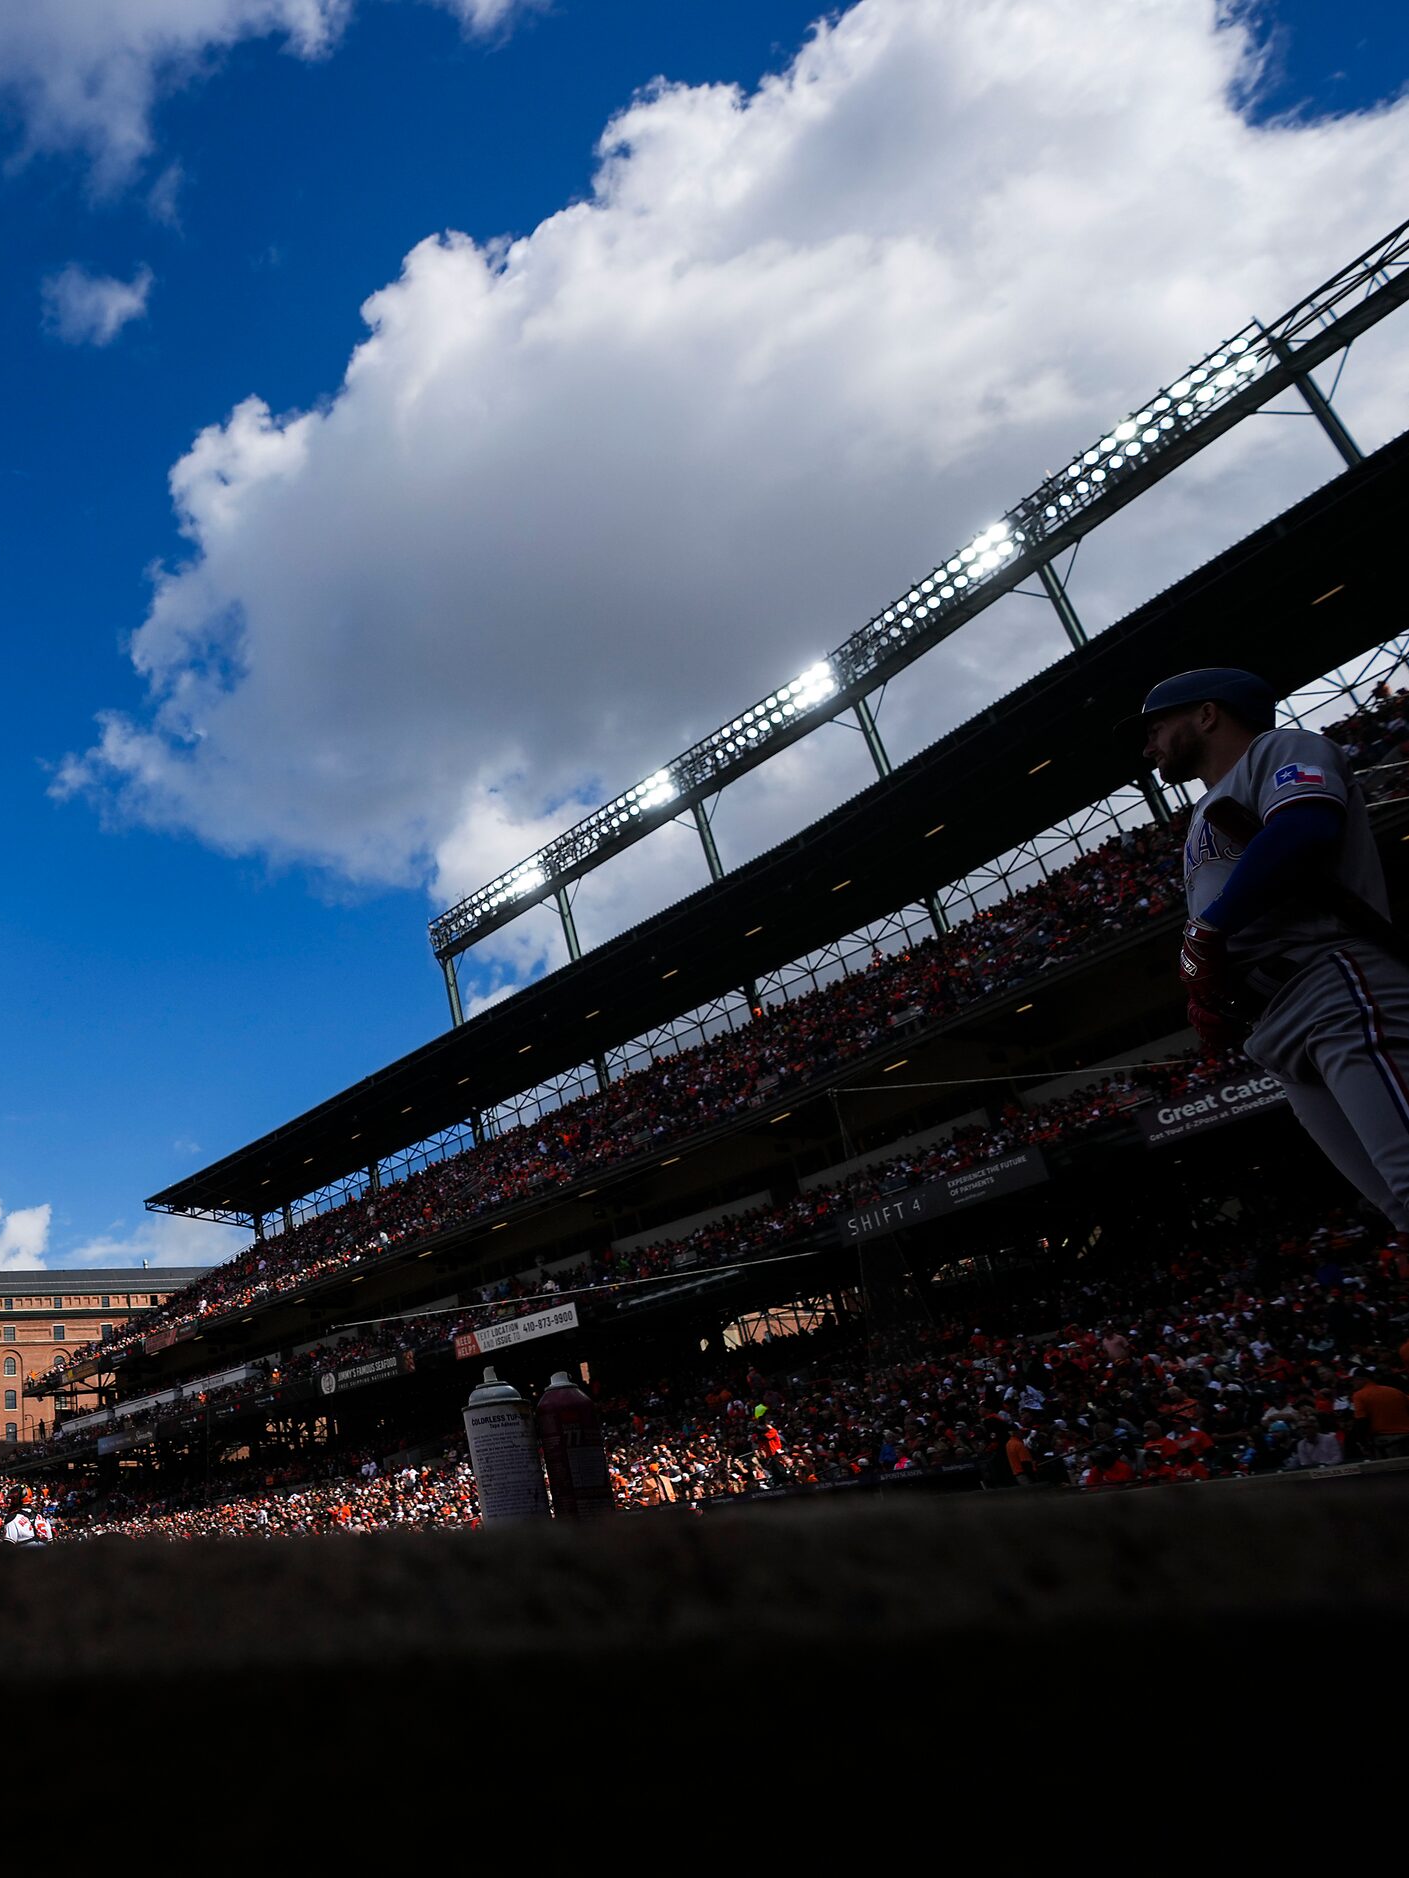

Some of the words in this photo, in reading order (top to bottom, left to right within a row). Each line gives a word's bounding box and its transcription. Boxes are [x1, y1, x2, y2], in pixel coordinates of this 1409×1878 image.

[1157, 1093, 1219, 1125] Great
[1149, 1132, 1165, 1142] Get
[1164, 1125, 1185, 1138] Your
[1219, 1110, 1230, 1119] at
[947, 1169, 987, 1189] EXPERIENCE
[986, 1163, 1000, 1174] THE
[1000, 1154, 1027, 1170] FUTURE
[949, 1188, 959, 1197] OF
[959, 1176, 995, 1193] PAYMENTS
[847, 1201, 904, 1236] SHIFT
[912, 1199, 921, 1212] 4
[477, 1330, 490, 1341] TEXT
[491, 1321, 519, 1337] LOCATION
[522, 1310, 573, 1333] 410-873-9900
[456, 1335, 472, 1347] NEED
[495, 1335, 512, 1347] ISSUE
[512, 1331, 521, 1341] TO
[457, 1345, 476, 1358] HELP?
[375, 1356, 397, 1371] SEAFOOD
[471, 1414, 506, 1426] COLORLESS
